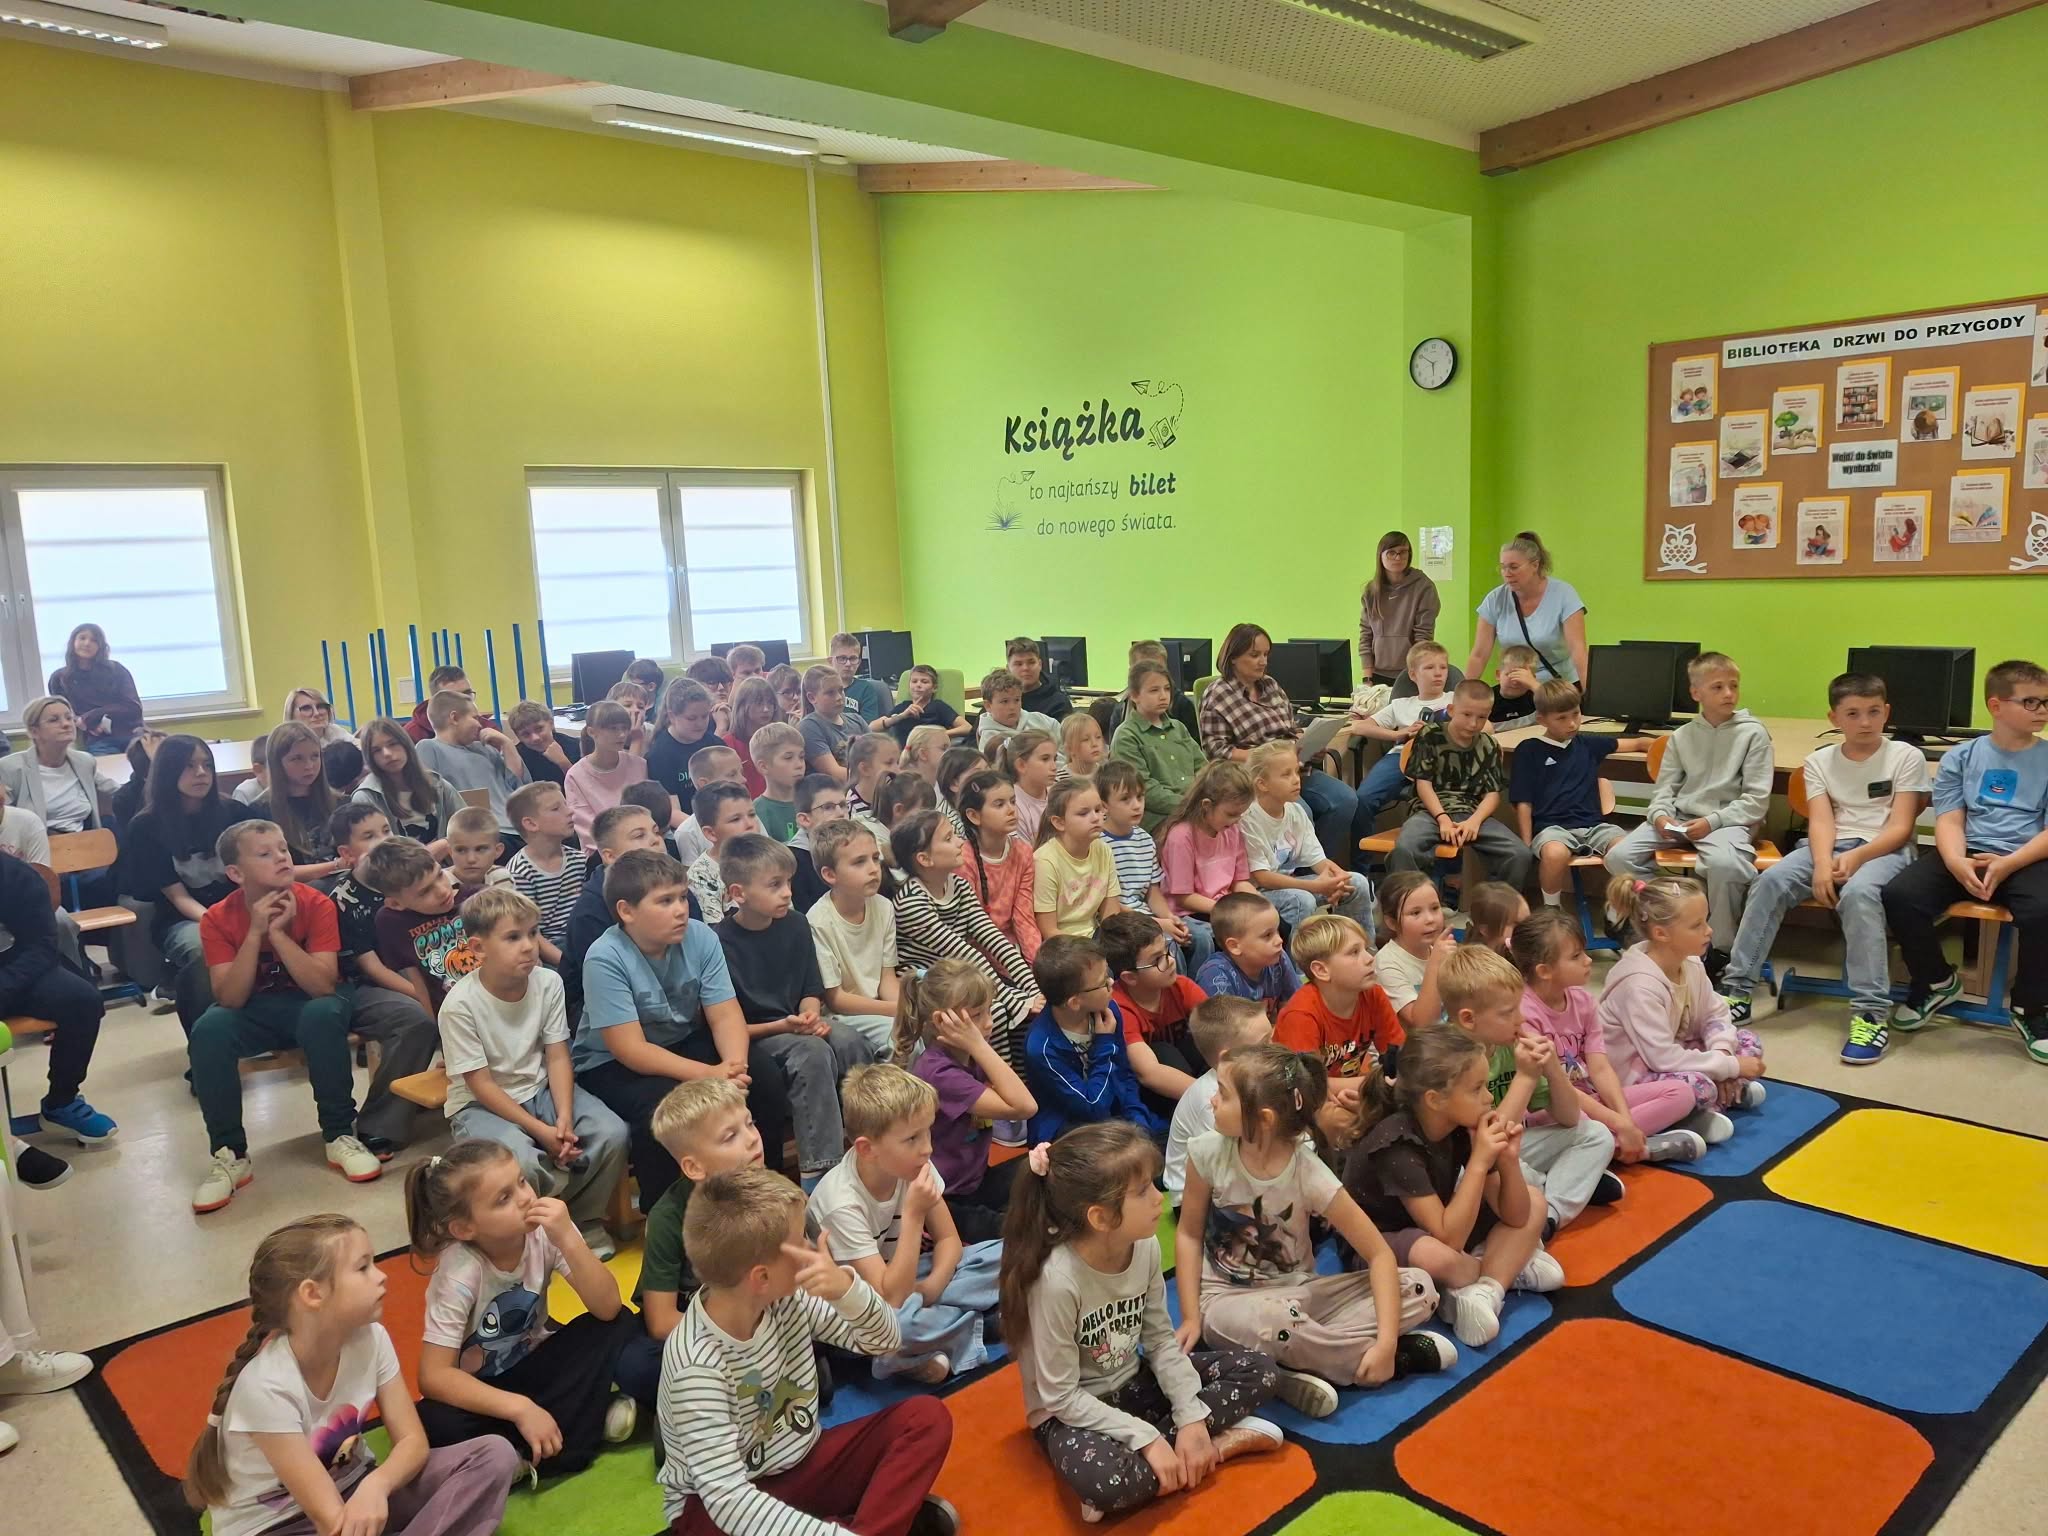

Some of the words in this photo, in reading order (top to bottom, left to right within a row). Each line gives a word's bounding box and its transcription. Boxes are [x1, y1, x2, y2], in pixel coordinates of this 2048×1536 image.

[1727, 339, 1820, 360] BIBLIOTEKA
[1833, 331, 1885, 348] DRZWI
[1894, 328, 1918, 341] DO
[1926, 315, 2025, 338] PRZYGODY
[1004, 398, 1145, 461] Książka
[1855, 450, 1866, 461] do
[1029, 485, 1044, 500] to
[1048, 478, 1119, 503] najtańszy
[1129, 472, 1177, 497] bilet
[1037, 518, 1054, 535] do
[1059, 517, 1116, 538] nowego
[1121, 512, 1176, 532] świata.
[414, 916, 465, 959] PUMP
[1079, 1329, 1107, 1347] AND
[1109, 1311, 1142, 1333] FRIEN
[1082, 1303, 1113, 1332] HELLO
[1118, 1292, 1147, 1315] KITT
